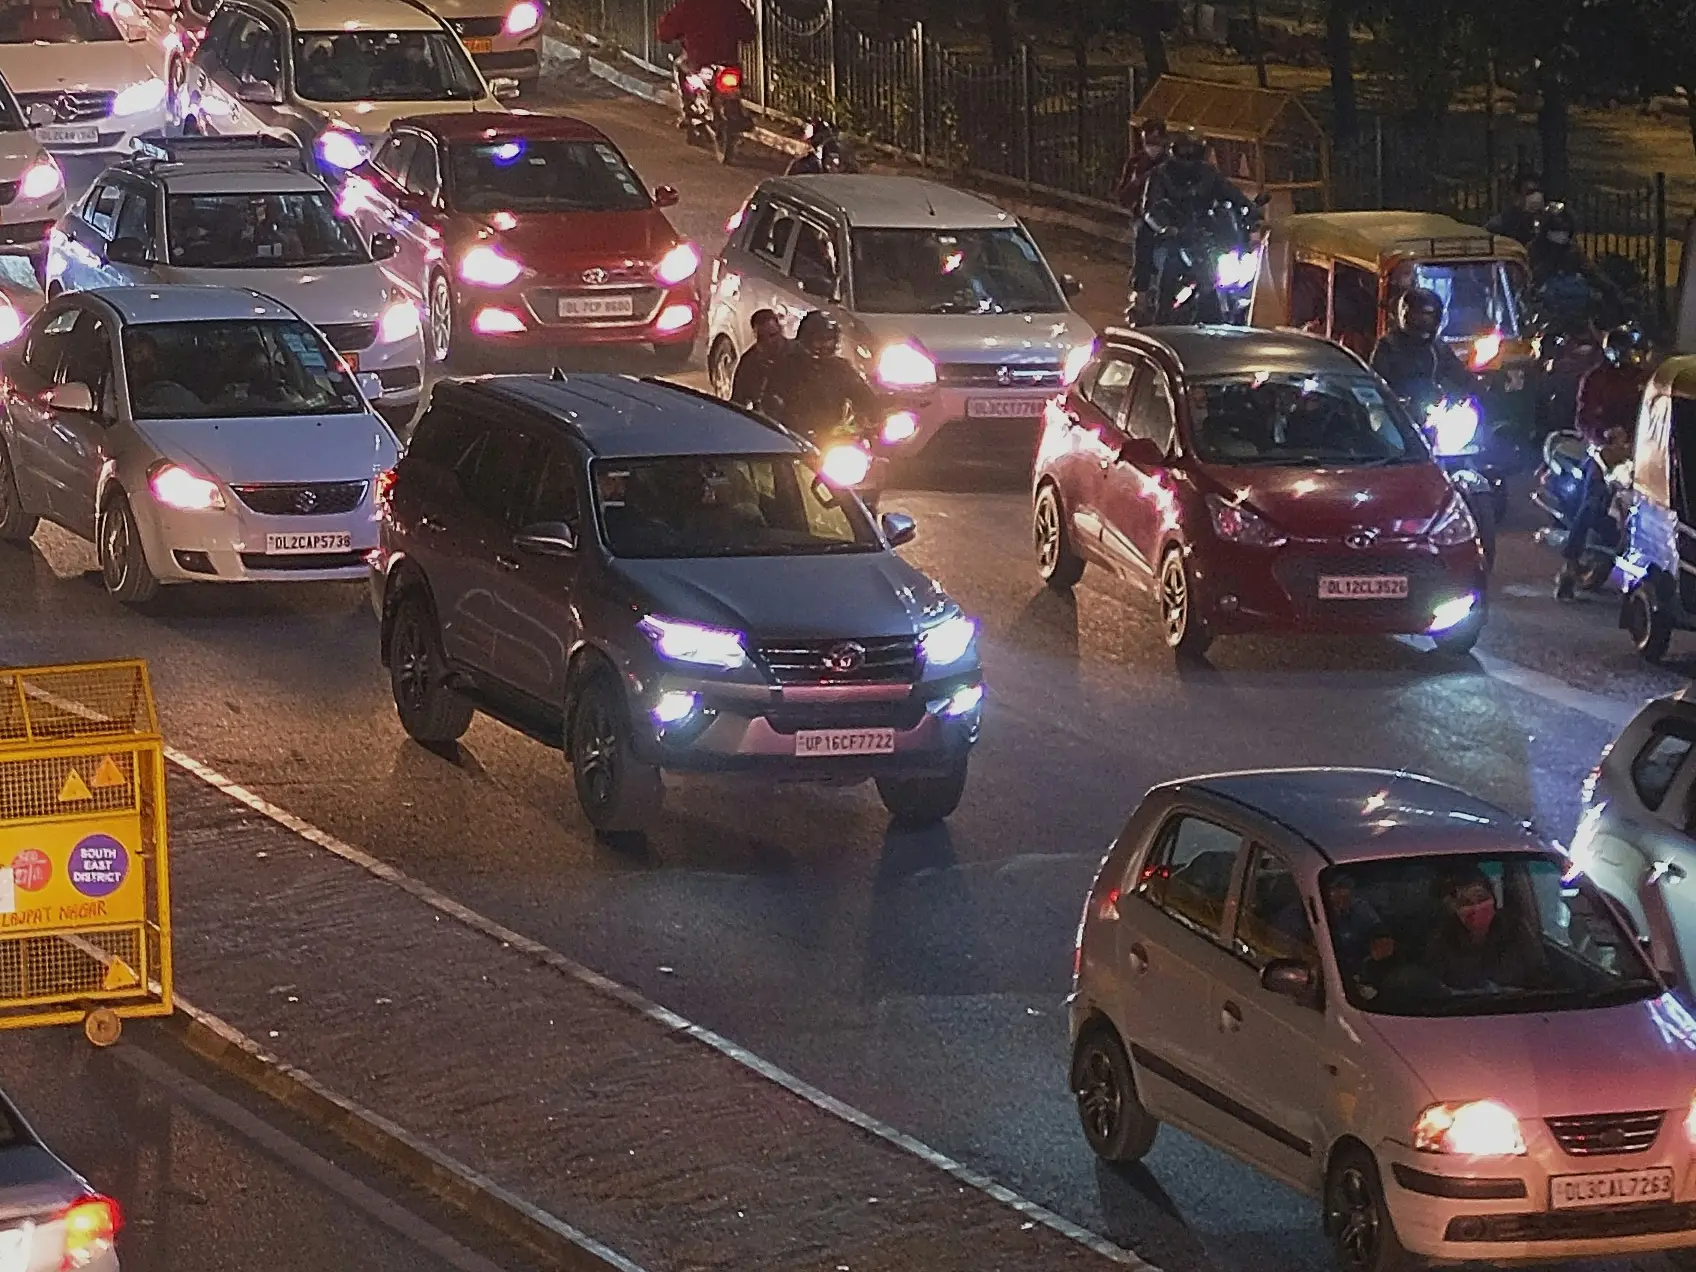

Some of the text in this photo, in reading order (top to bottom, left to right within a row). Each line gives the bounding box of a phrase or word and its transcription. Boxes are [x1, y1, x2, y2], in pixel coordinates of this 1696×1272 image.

[80, 847, 117, 860] SOUTH
[83, 859, 113, 871] EAST
[72, 871, 122, 884] DISTRICT
